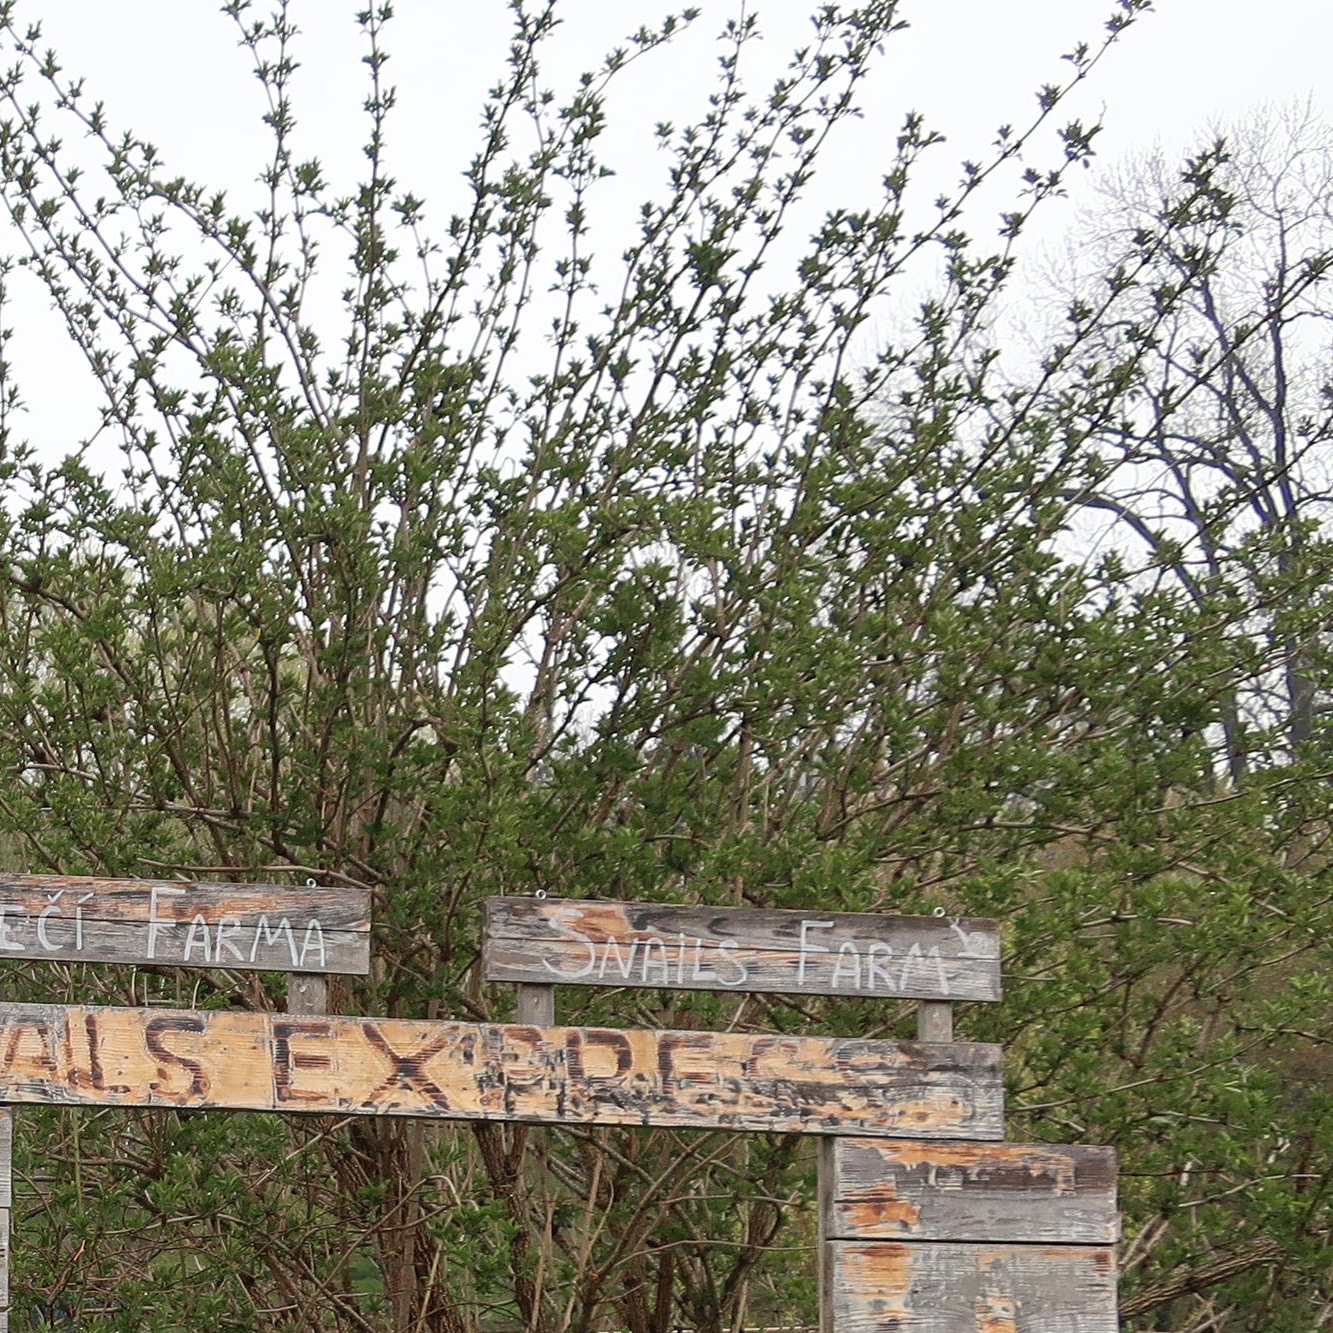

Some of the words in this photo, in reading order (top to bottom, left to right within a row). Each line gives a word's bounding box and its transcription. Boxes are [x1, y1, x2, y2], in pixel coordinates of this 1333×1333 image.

[147, 886, 327, 967] FARMA
[541, 907, 749, 985] SNAILS
[797, 919, 951, 996] FARM
